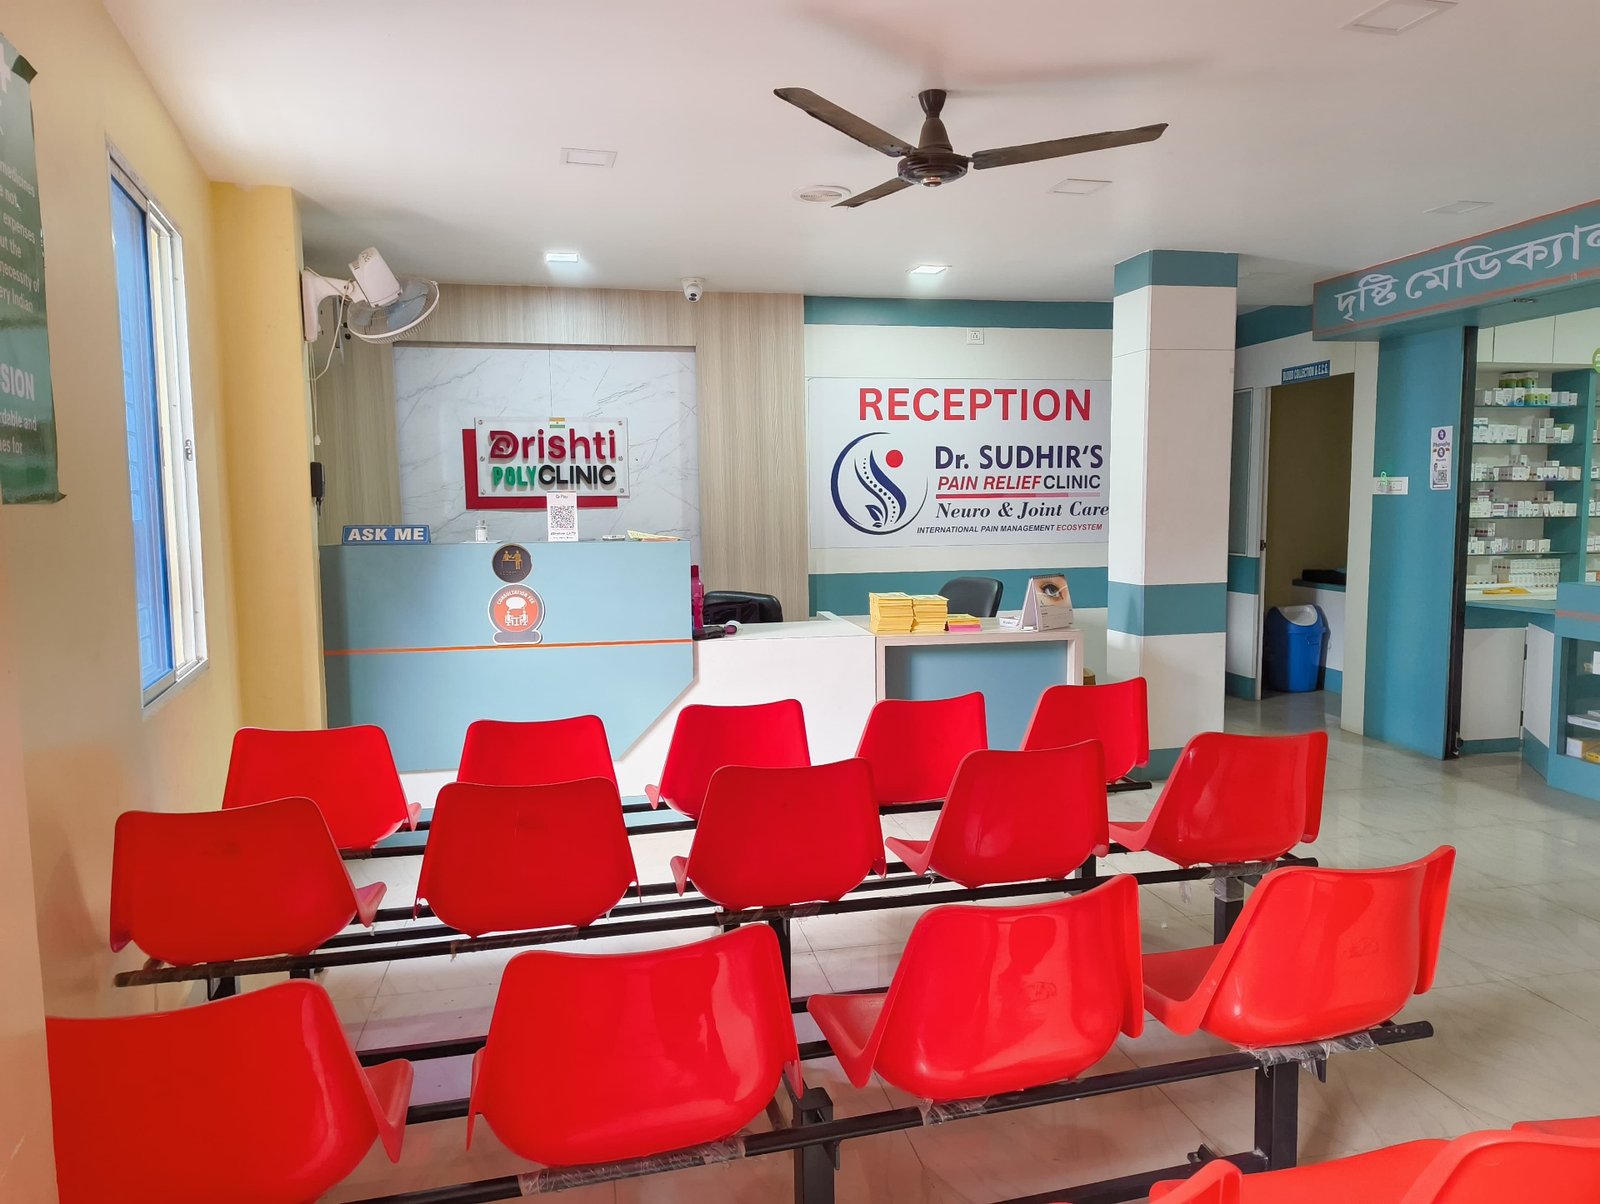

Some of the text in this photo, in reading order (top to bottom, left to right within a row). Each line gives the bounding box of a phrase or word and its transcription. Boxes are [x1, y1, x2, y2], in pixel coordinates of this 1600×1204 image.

[3, 211, 36, 245] expenses
[9, 239, 22, 258] the
[33, 277, 40, 294] of
[12, 287, 34, 313] Indian
[1334, 273, 1399, 322] দৃষ্টি
[858, 387, 1091, 422] RECEPTION
[23, 415, 38, 432] and
[12, 435, 23, 456] for
[489, 428, 617, 460] Drishti
[935, 444, 1104, 470] Dr. SUDHIR'S
[937, 474, 1101, 491] PAIN RELIEF CLINIC
[936, 501, 1109, 519] Neuro & Joint Care
[347, 527, 424, 541] ASK ME
[916, 523, 1103, 534] INTERNATIONAL PAIN MANAGEMENT ECOSYSTEM
